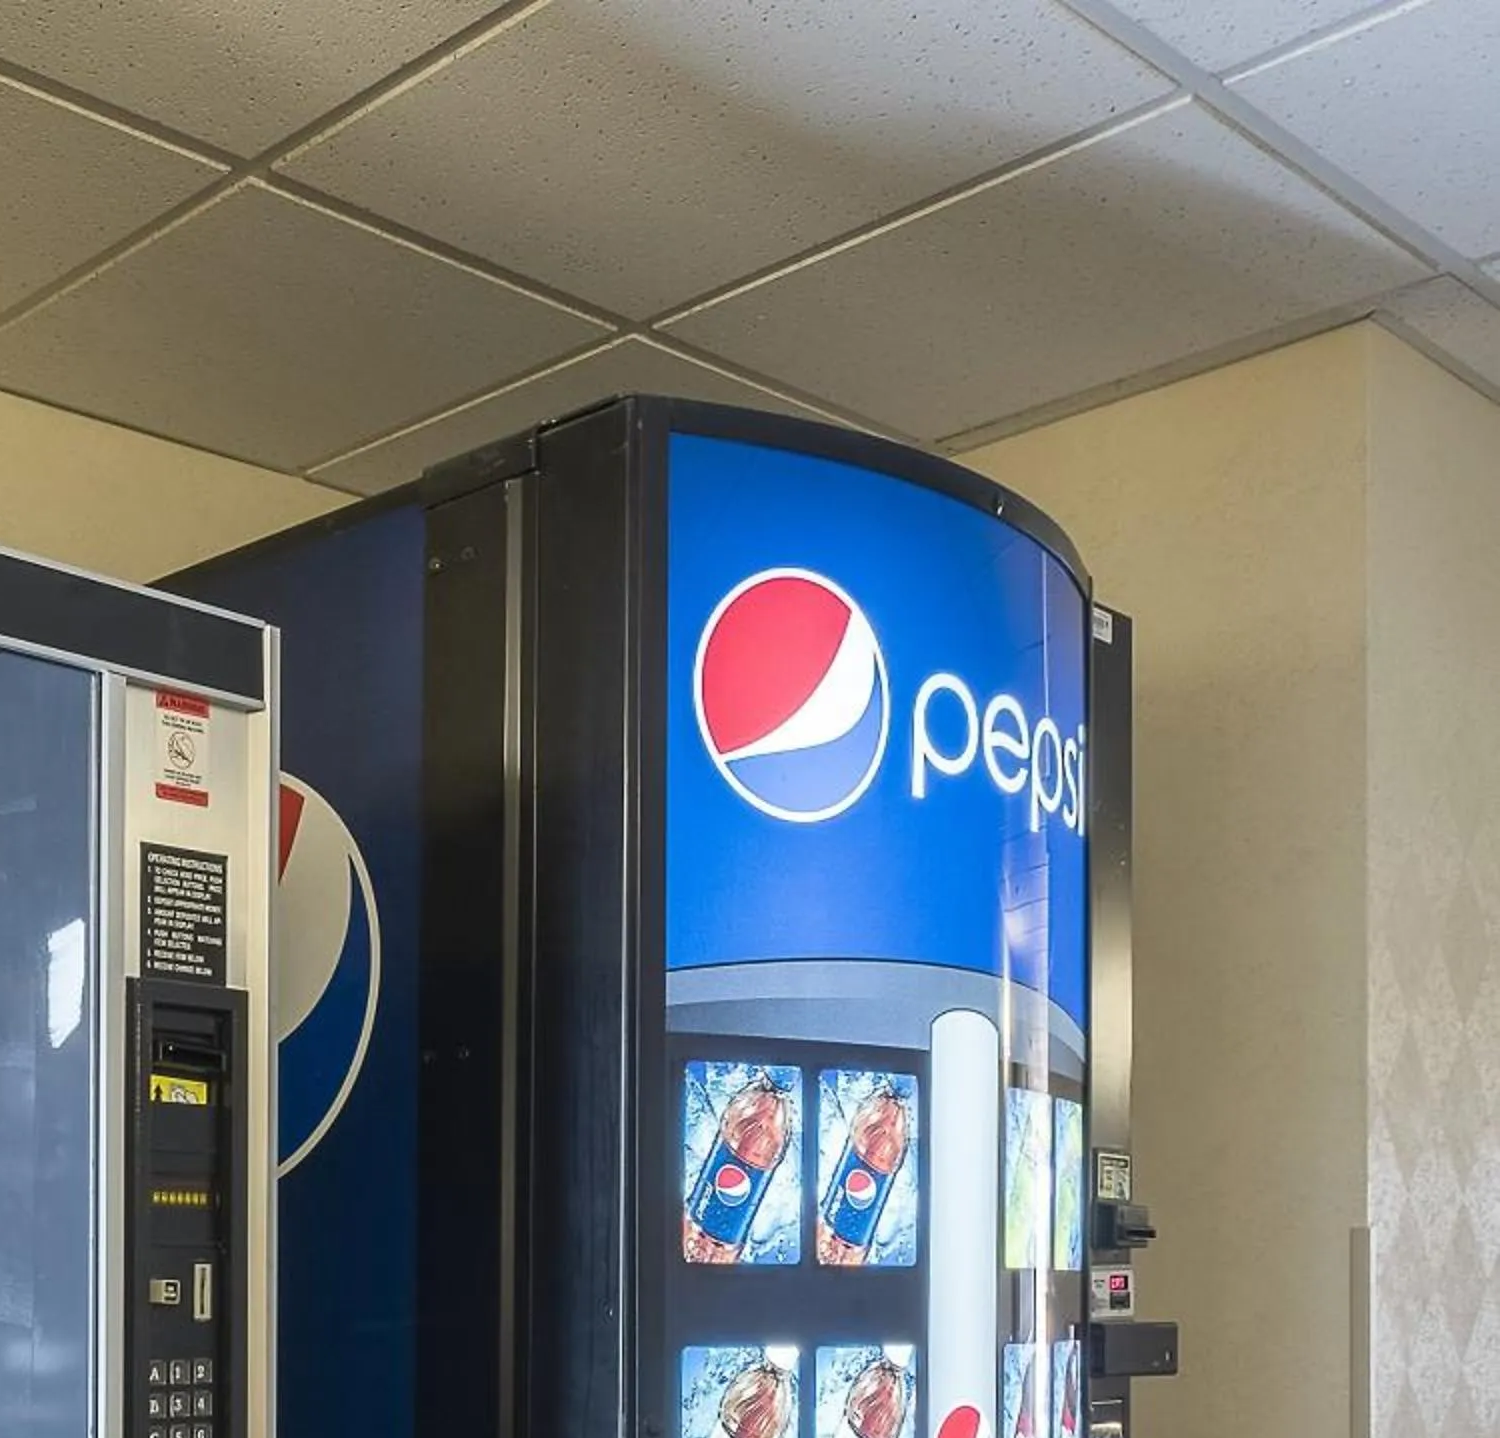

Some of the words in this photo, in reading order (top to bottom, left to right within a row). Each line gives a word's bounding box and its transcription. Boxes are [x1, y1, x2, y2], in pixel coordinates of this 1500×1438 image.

[911, 672, 1085, 838] pepsi
[150, 1367, 160, 1381] A
[174, 1366, 181, 1379] 1
[197, 1364, 205, 1378] 2
[174, 1399, 183, 1412] 3
[197, 1397, 205, 1410] 4
